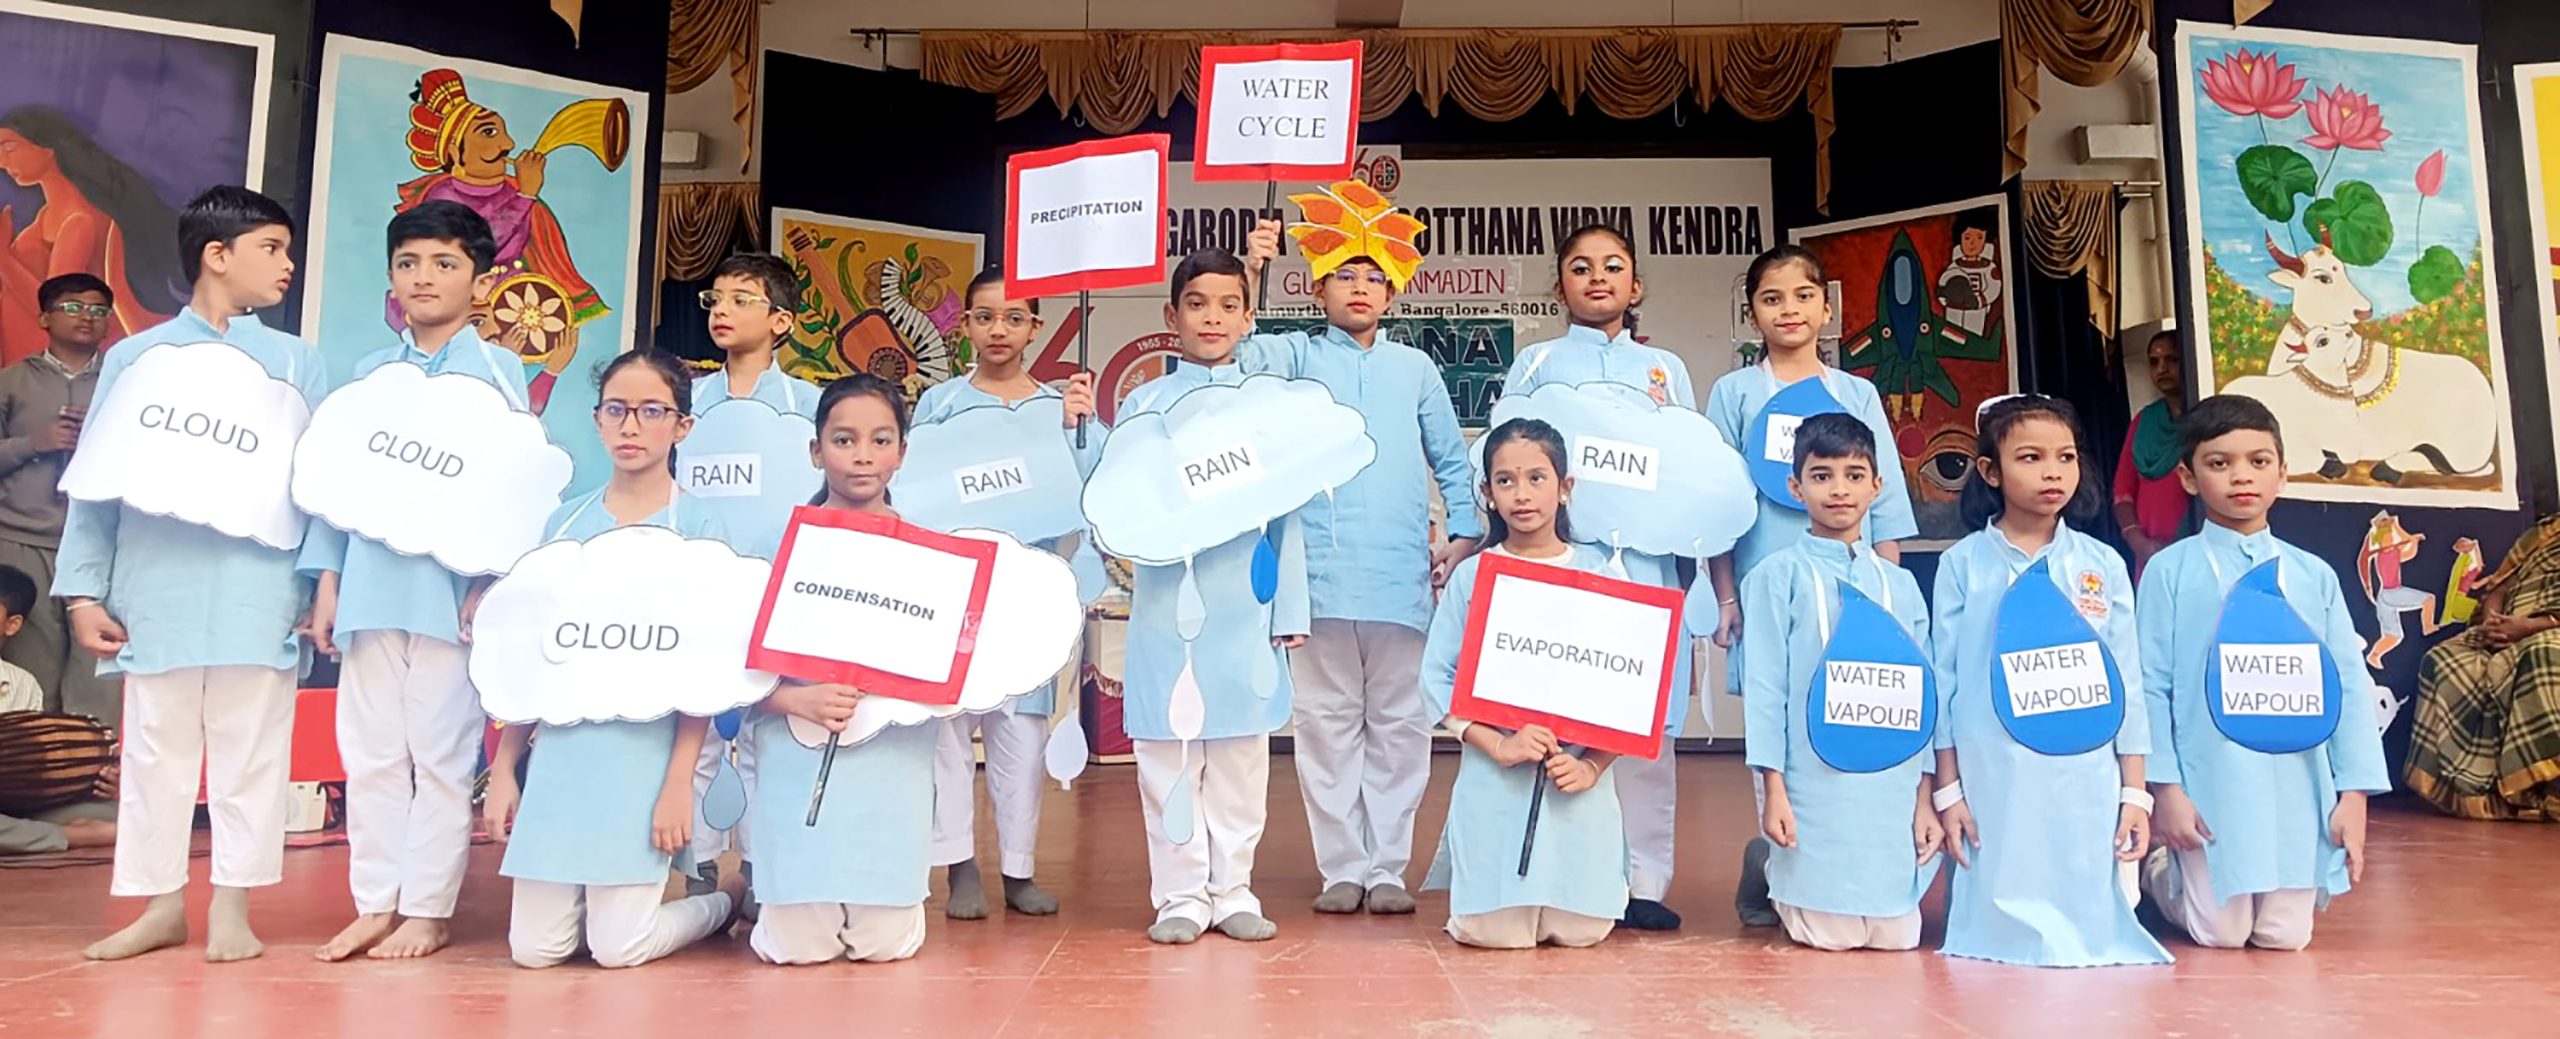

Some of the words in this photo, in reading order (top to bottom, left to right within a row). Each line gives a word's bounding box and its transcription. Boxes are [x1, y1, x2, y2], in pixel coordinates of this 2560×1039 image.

[1242, 78, 1329, 100] WATER
[1238, 115, 1327, 139] CYCLE
[1030, 199, 1143, 225] PRECIPITATION
[1649, 206, 1764, 255] KENDRA
[1400, 303, 1487, 318] Bangalore
[139, 404, 259, 454] CLOUD
[368, 430, 464, 478] CLOUD
[1184, 447, 1252, 486] RAIN
[1581, 445, 1648, 477] RAIN
[692, 463, 753, 486] RAIN
[961, 466, 1023, 495] RAIN
[793, 580, 935, 621] CONDENSATION
[555, 621, 680, 652] CLOUD
[1495, 632, 1644, 677] EVAPORATION
[2008, 646, 2088, 674] WATER
[2225, 654, 2304, 675] WATER
[1828, 663, 1906, 690] WATER
[2014, 683, 2109, 712] VAPOUR
[2225, 692, 2320, 714] VAPOUR
[1827, 699, 1919, 730] VAPOUR
